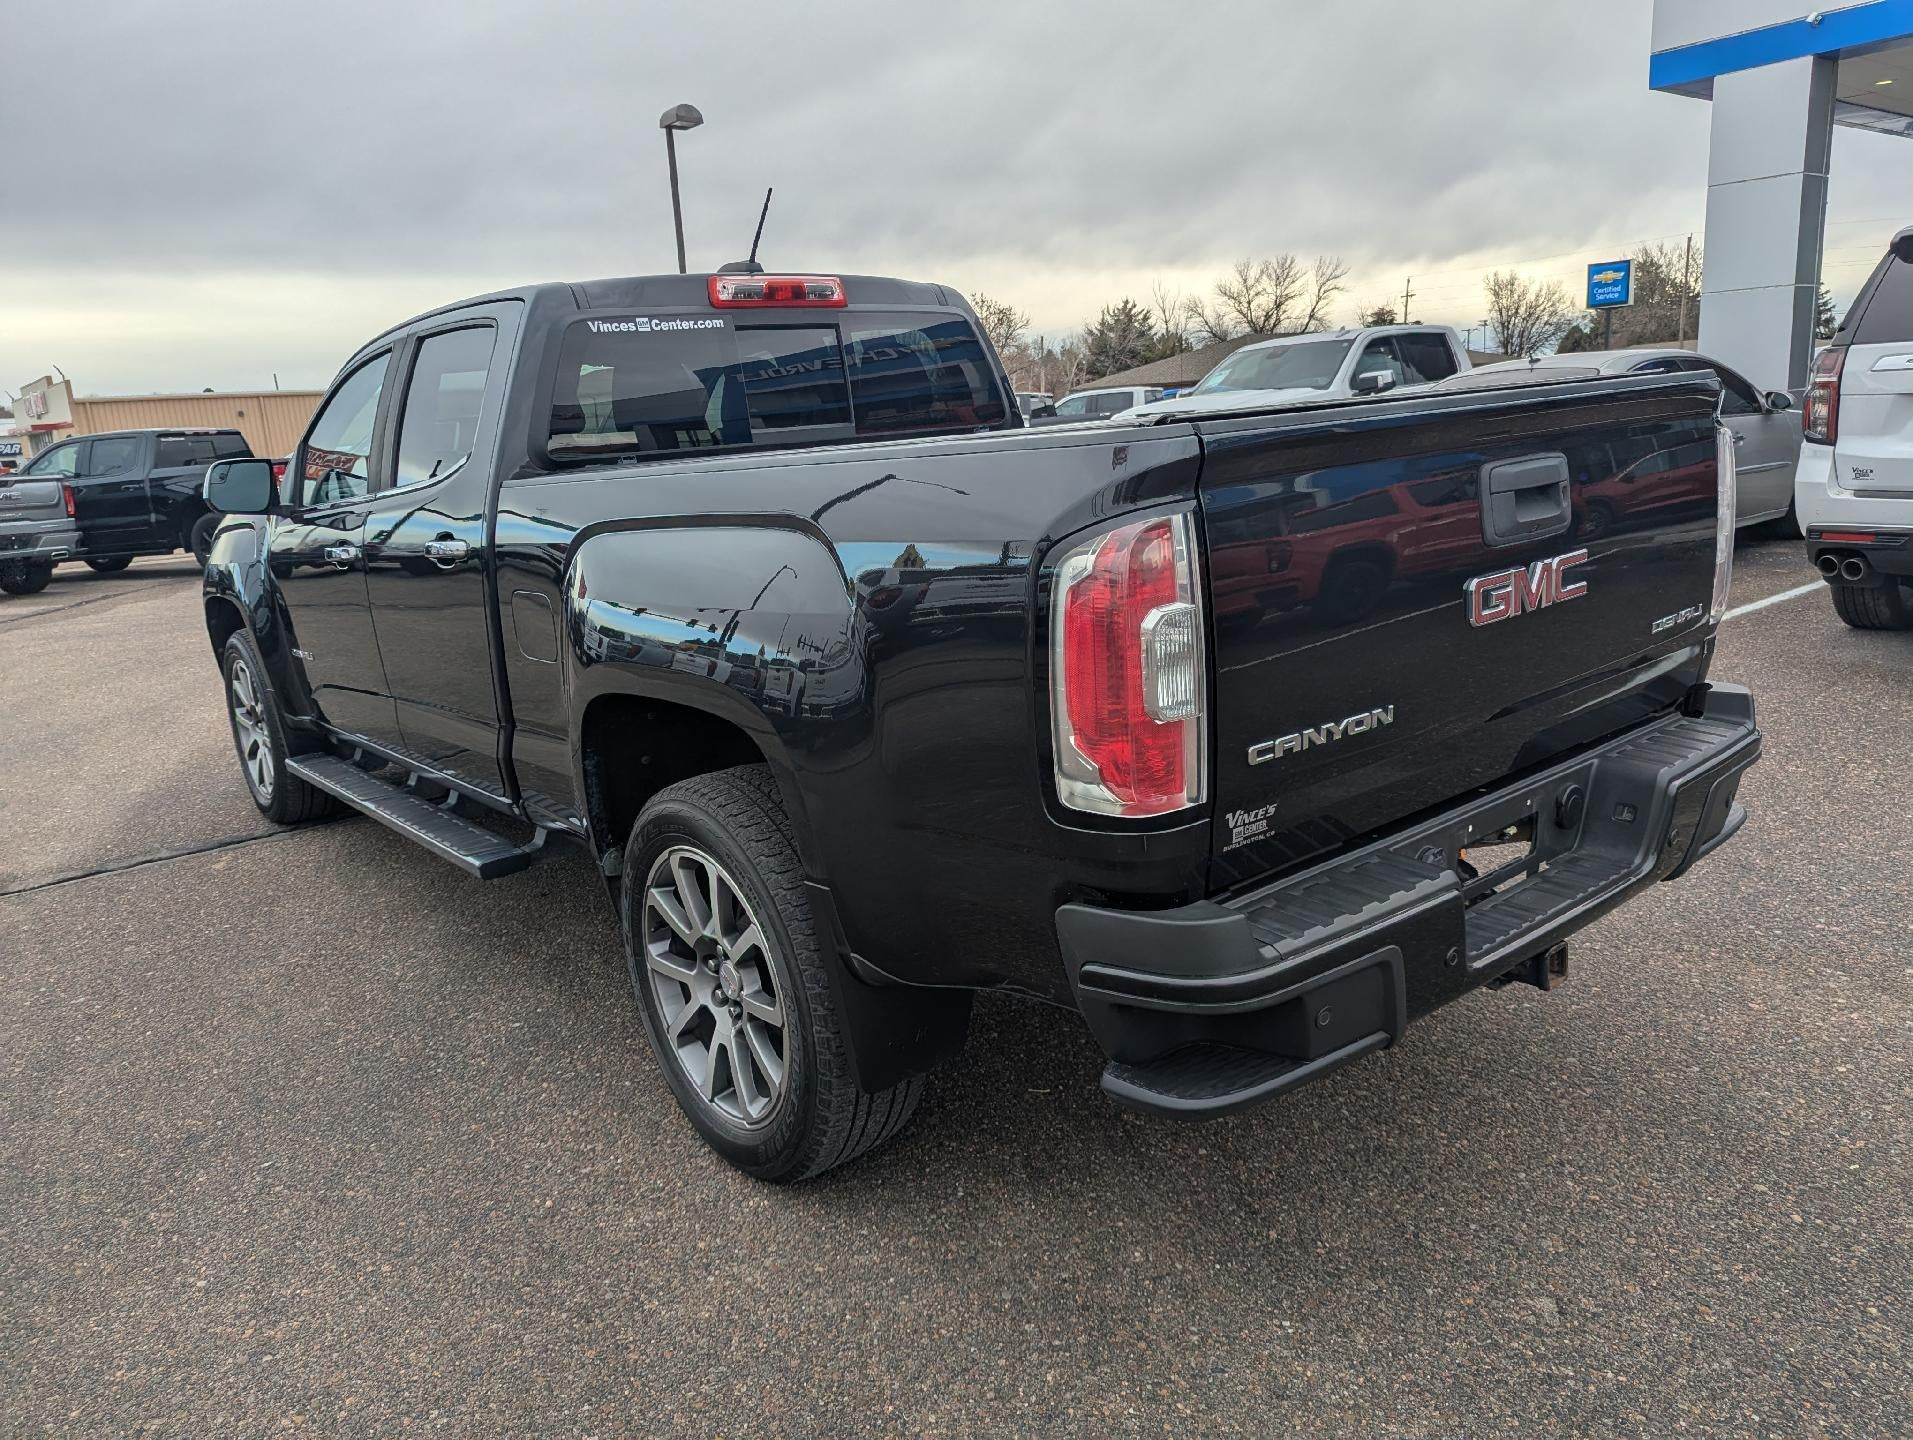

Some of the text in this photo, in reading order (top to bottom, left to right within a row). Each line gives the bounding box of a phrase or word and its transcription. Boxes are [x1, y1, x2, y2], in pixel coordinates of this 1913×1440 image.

[1594, 285, 1621, 294] Certified
[587, 321, 636, 332] Vinces
[651, 319, 724, 331] Center.com
[1464, 548, 1588, 627] GMC
[1651, 604, 1702, 635] DENALI
[1248, 705, 1394, 766] CANYON
[1245, 820, 1268, 835] CENTER
